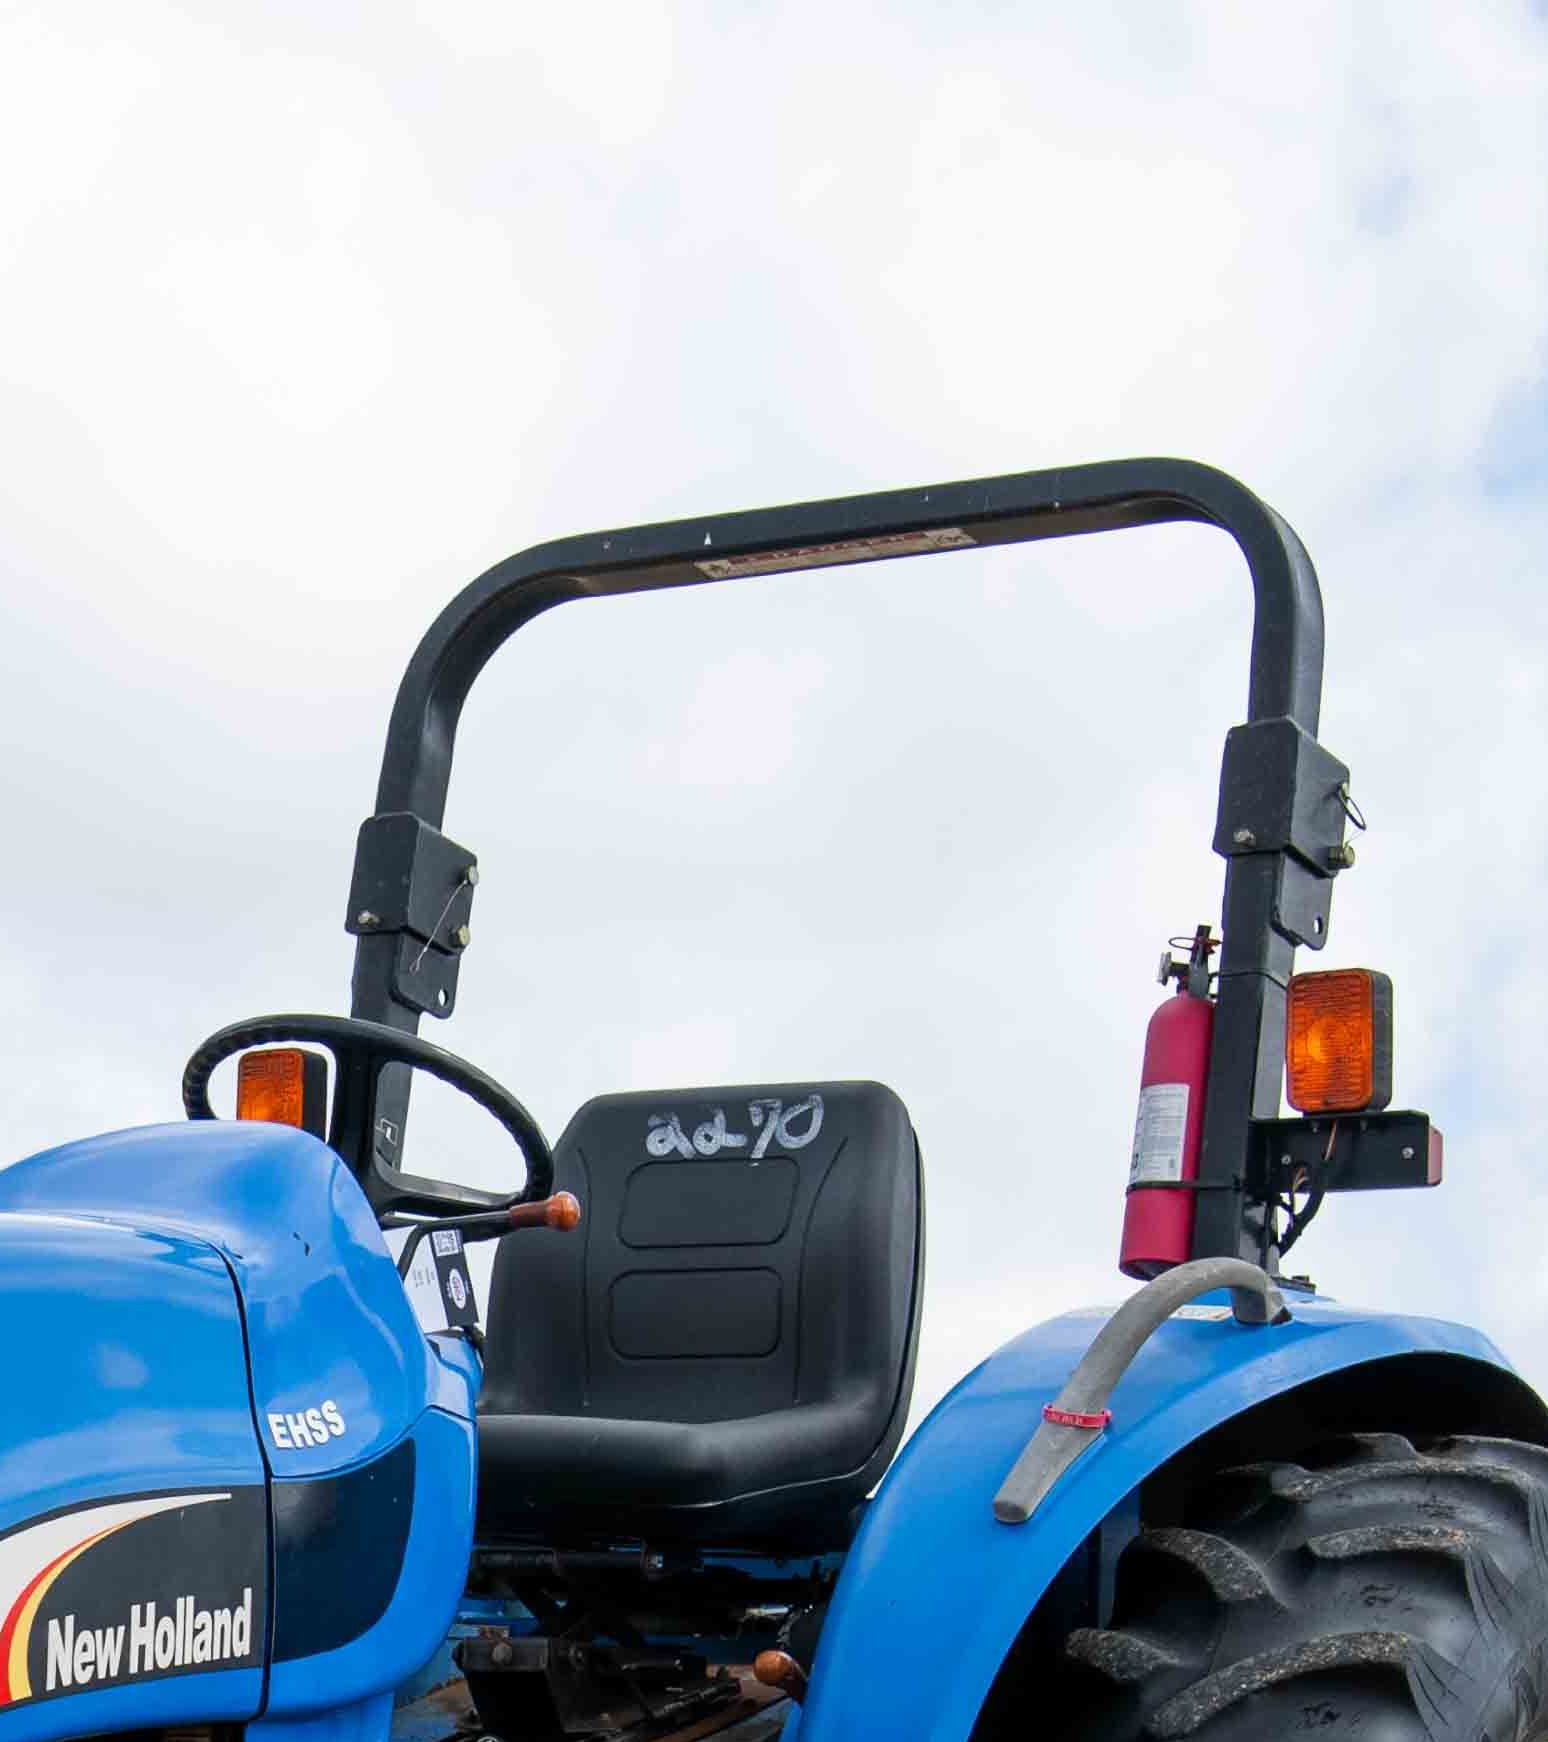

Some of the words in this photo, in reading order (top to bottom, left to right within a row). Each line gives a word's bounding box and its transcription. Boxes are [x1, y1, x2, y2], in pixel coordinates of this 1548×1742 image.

[268, 1400, 345, 1448] EHSS
[46, 1614, 126, 1691] New
[129, 1587, 253, 1675] Holland
